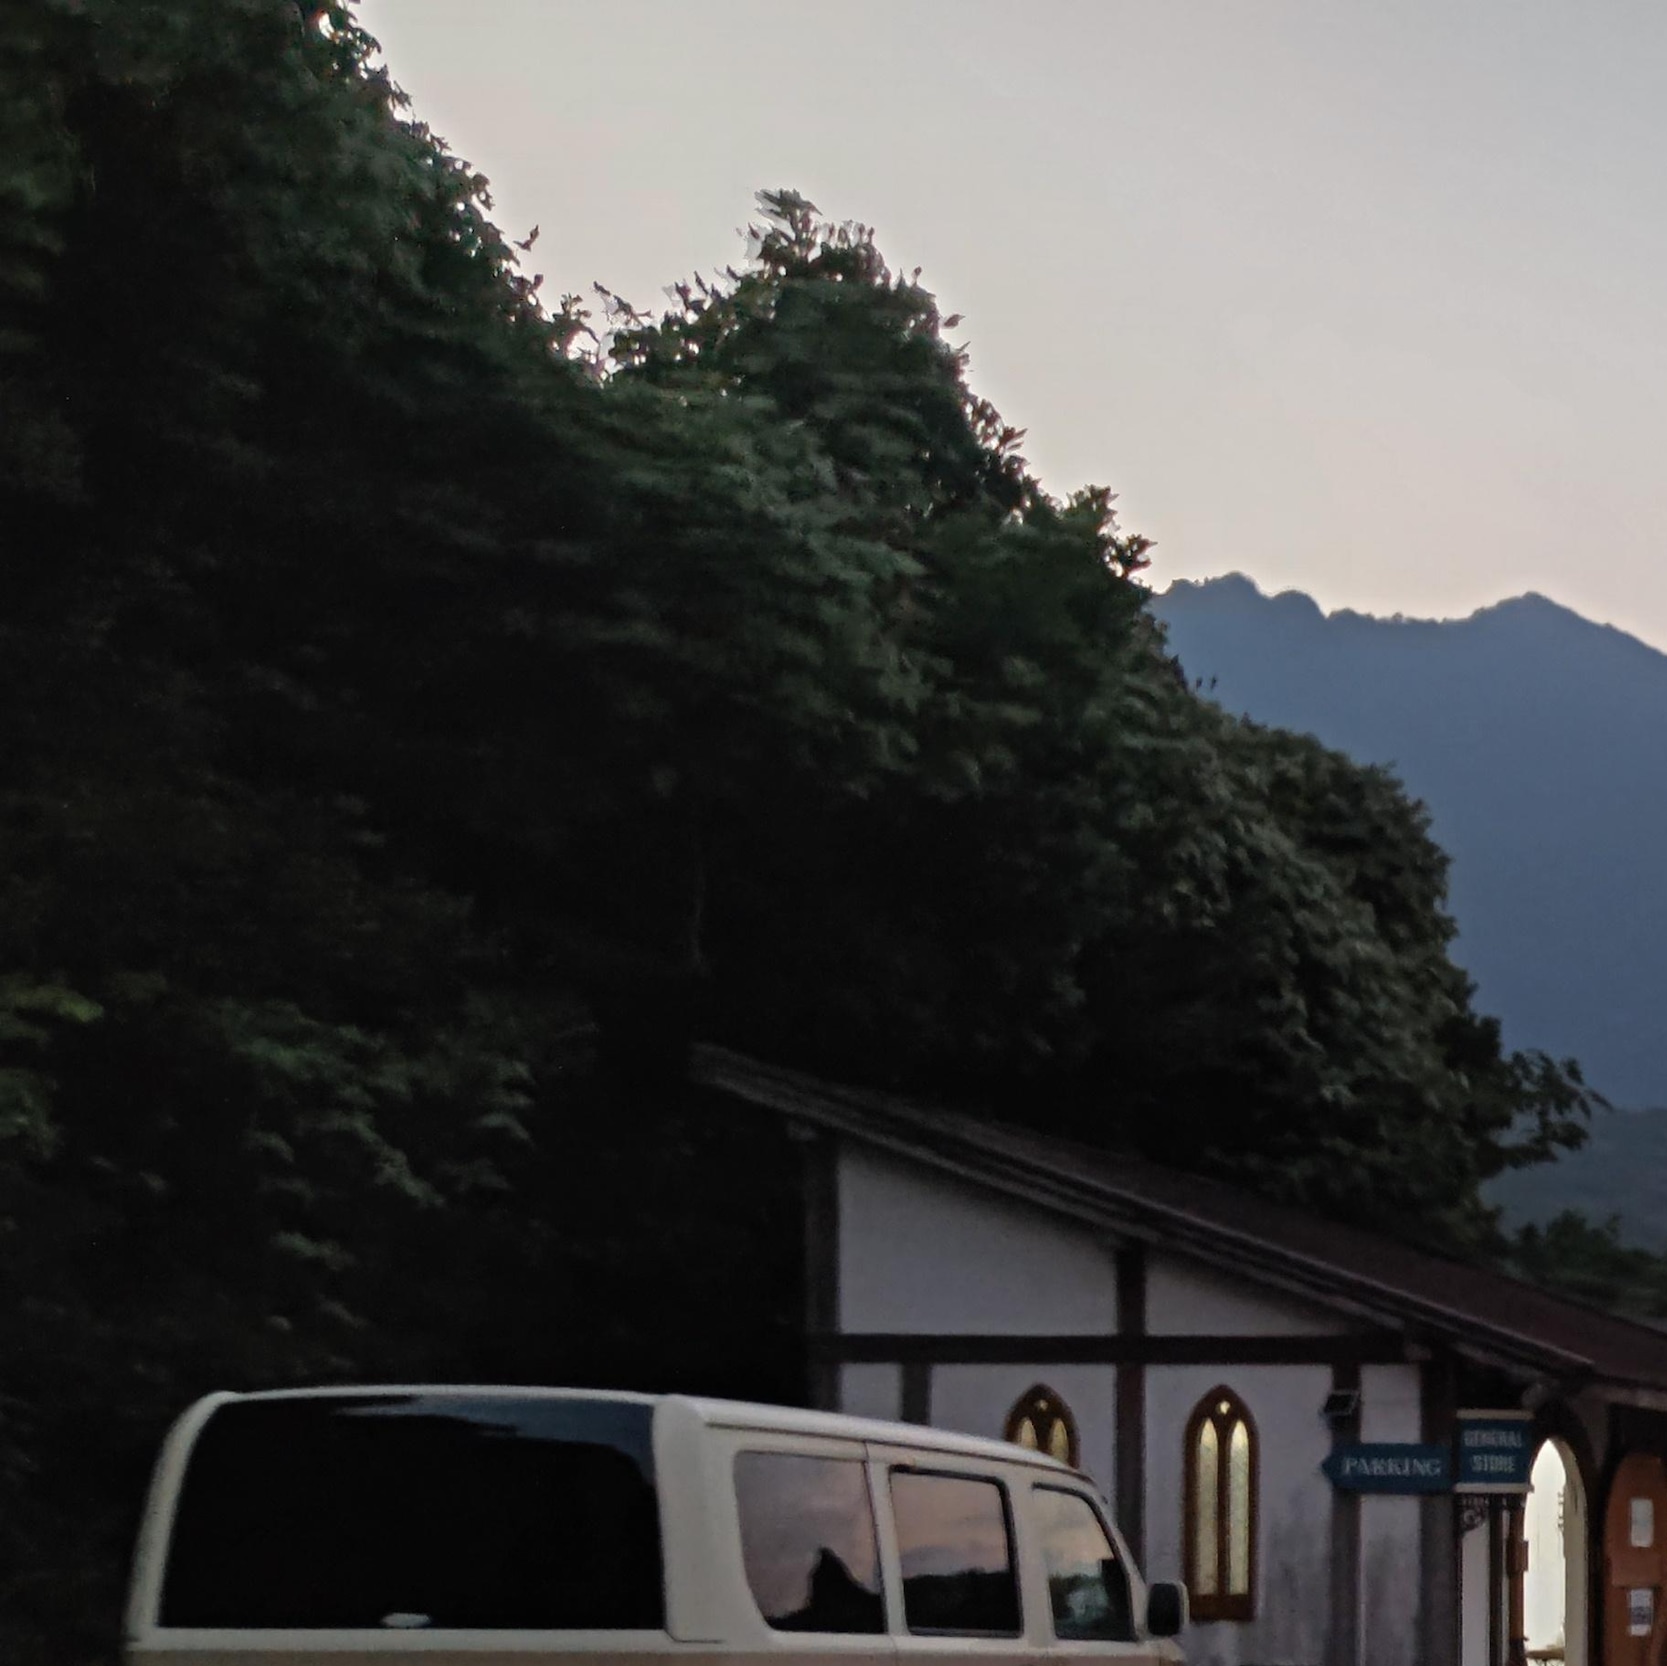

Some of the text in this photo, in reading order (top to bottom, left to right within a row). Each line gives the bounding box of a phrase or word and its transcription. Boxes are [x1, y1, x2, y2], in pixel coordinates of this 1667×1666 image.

[1464, 1430, 1522, 1447] GENERAL
[1343, 1457, 1442, 1477] PARKING
[1472, 1454, 1516, 1473] STORE
